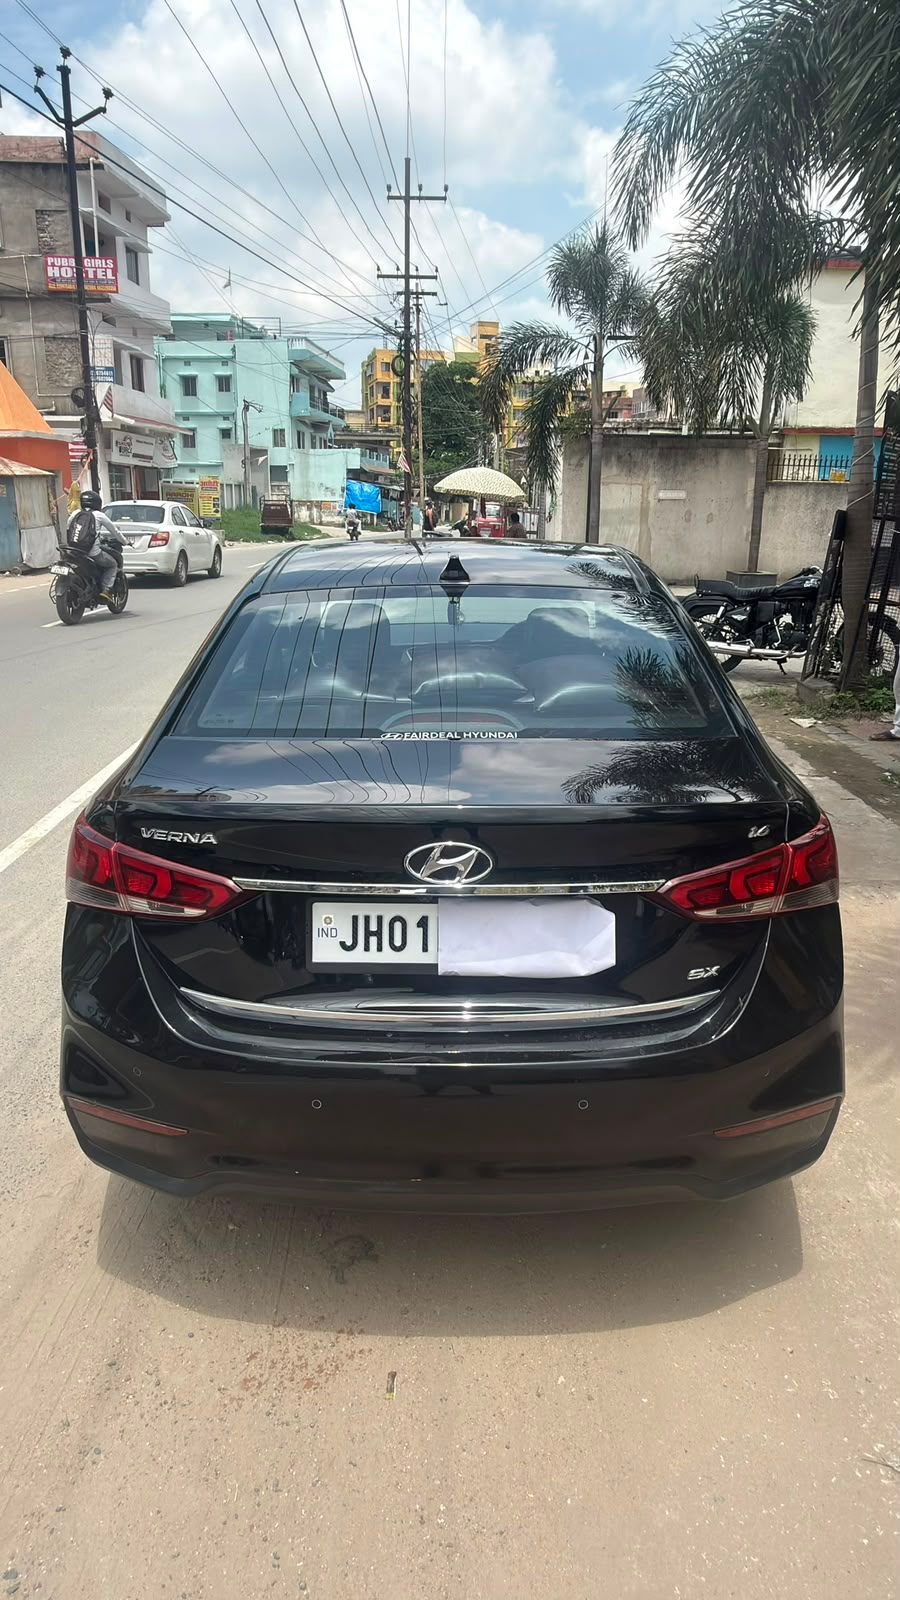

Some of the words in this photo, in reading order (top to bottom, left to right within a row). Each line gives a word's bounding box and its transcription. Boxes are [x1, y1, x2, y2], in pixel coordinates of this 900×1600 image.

[84, 258, 114, 268] GIRLS
[403, 731, 461, 739] FAIRDEAL
[463, 731, 518, 739] HYUNDAI
[140, 827, 218, 845] VERNA
[748, 825, 770, 838] 1.6
[317, 927, 338, 938] IND
[339, 914, 429, 953] JH01
[687, 965, 720, 980] SX
